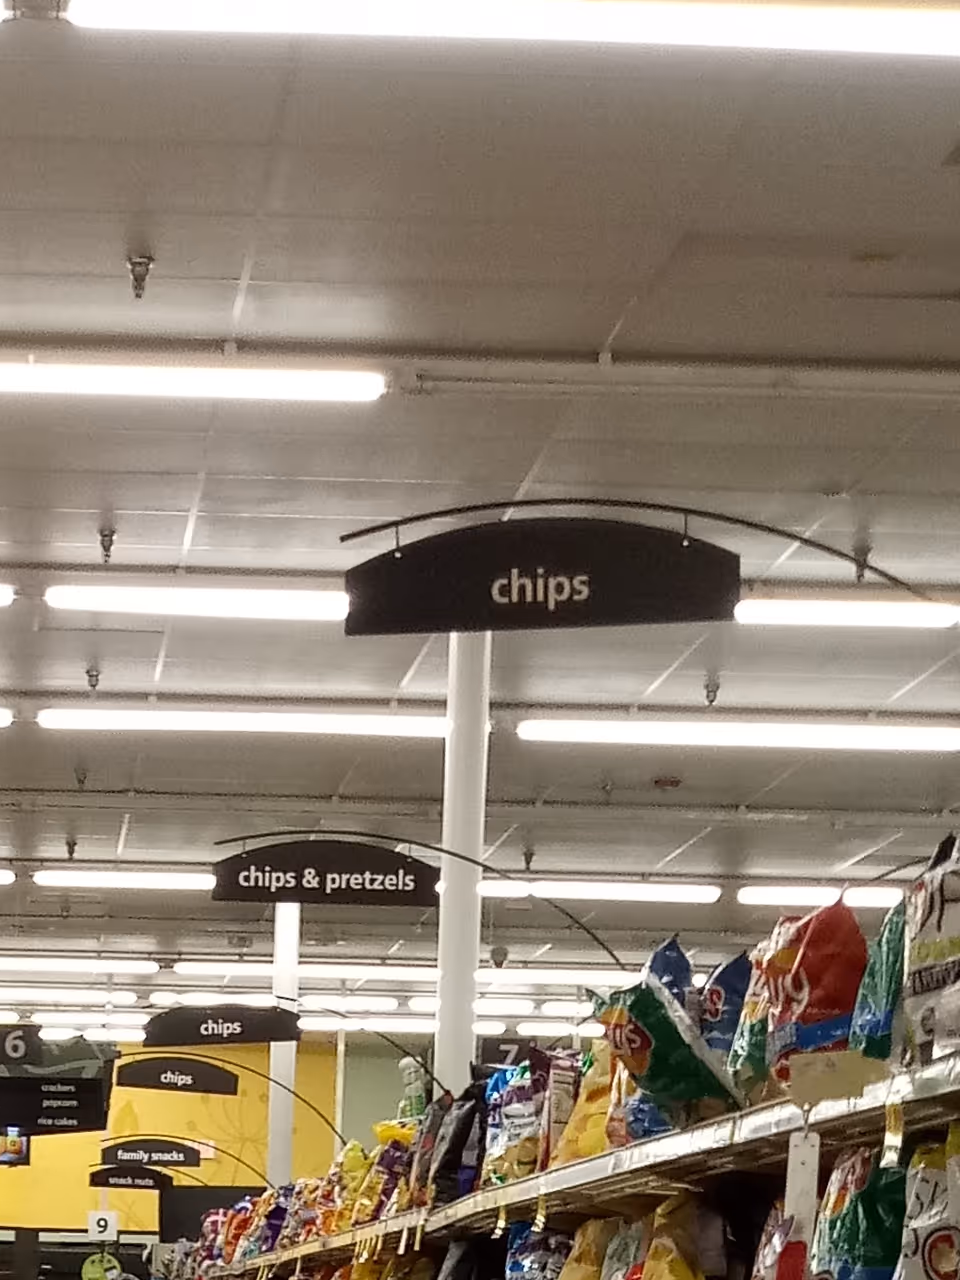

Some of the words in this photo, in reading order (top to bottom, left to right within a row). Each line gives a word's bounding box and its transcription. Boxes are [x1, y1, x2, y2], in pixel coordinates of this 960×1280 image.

[491, 566, 590, 610] chips
[237, 864, 297, 892] chips
[301, 867, 321, 888] &
[325, 867, 416, 895] pretzels
[199, 1019, 242, 1038] chips
[4, 1030, 26, 1058] 6
[499, 1044, 519, 1066] 7
[41, 1083, 76, 1092] crackers
[160, 1070, 194, 1087] chips
[116, 1149, 150, 1163] family
[150, 1151, 186, 1162] snacks
[108, 1175, 133, 1187] snack
[133, 1177, 155, 1188] nuts
[96, 1217, 108, 1234] 9
